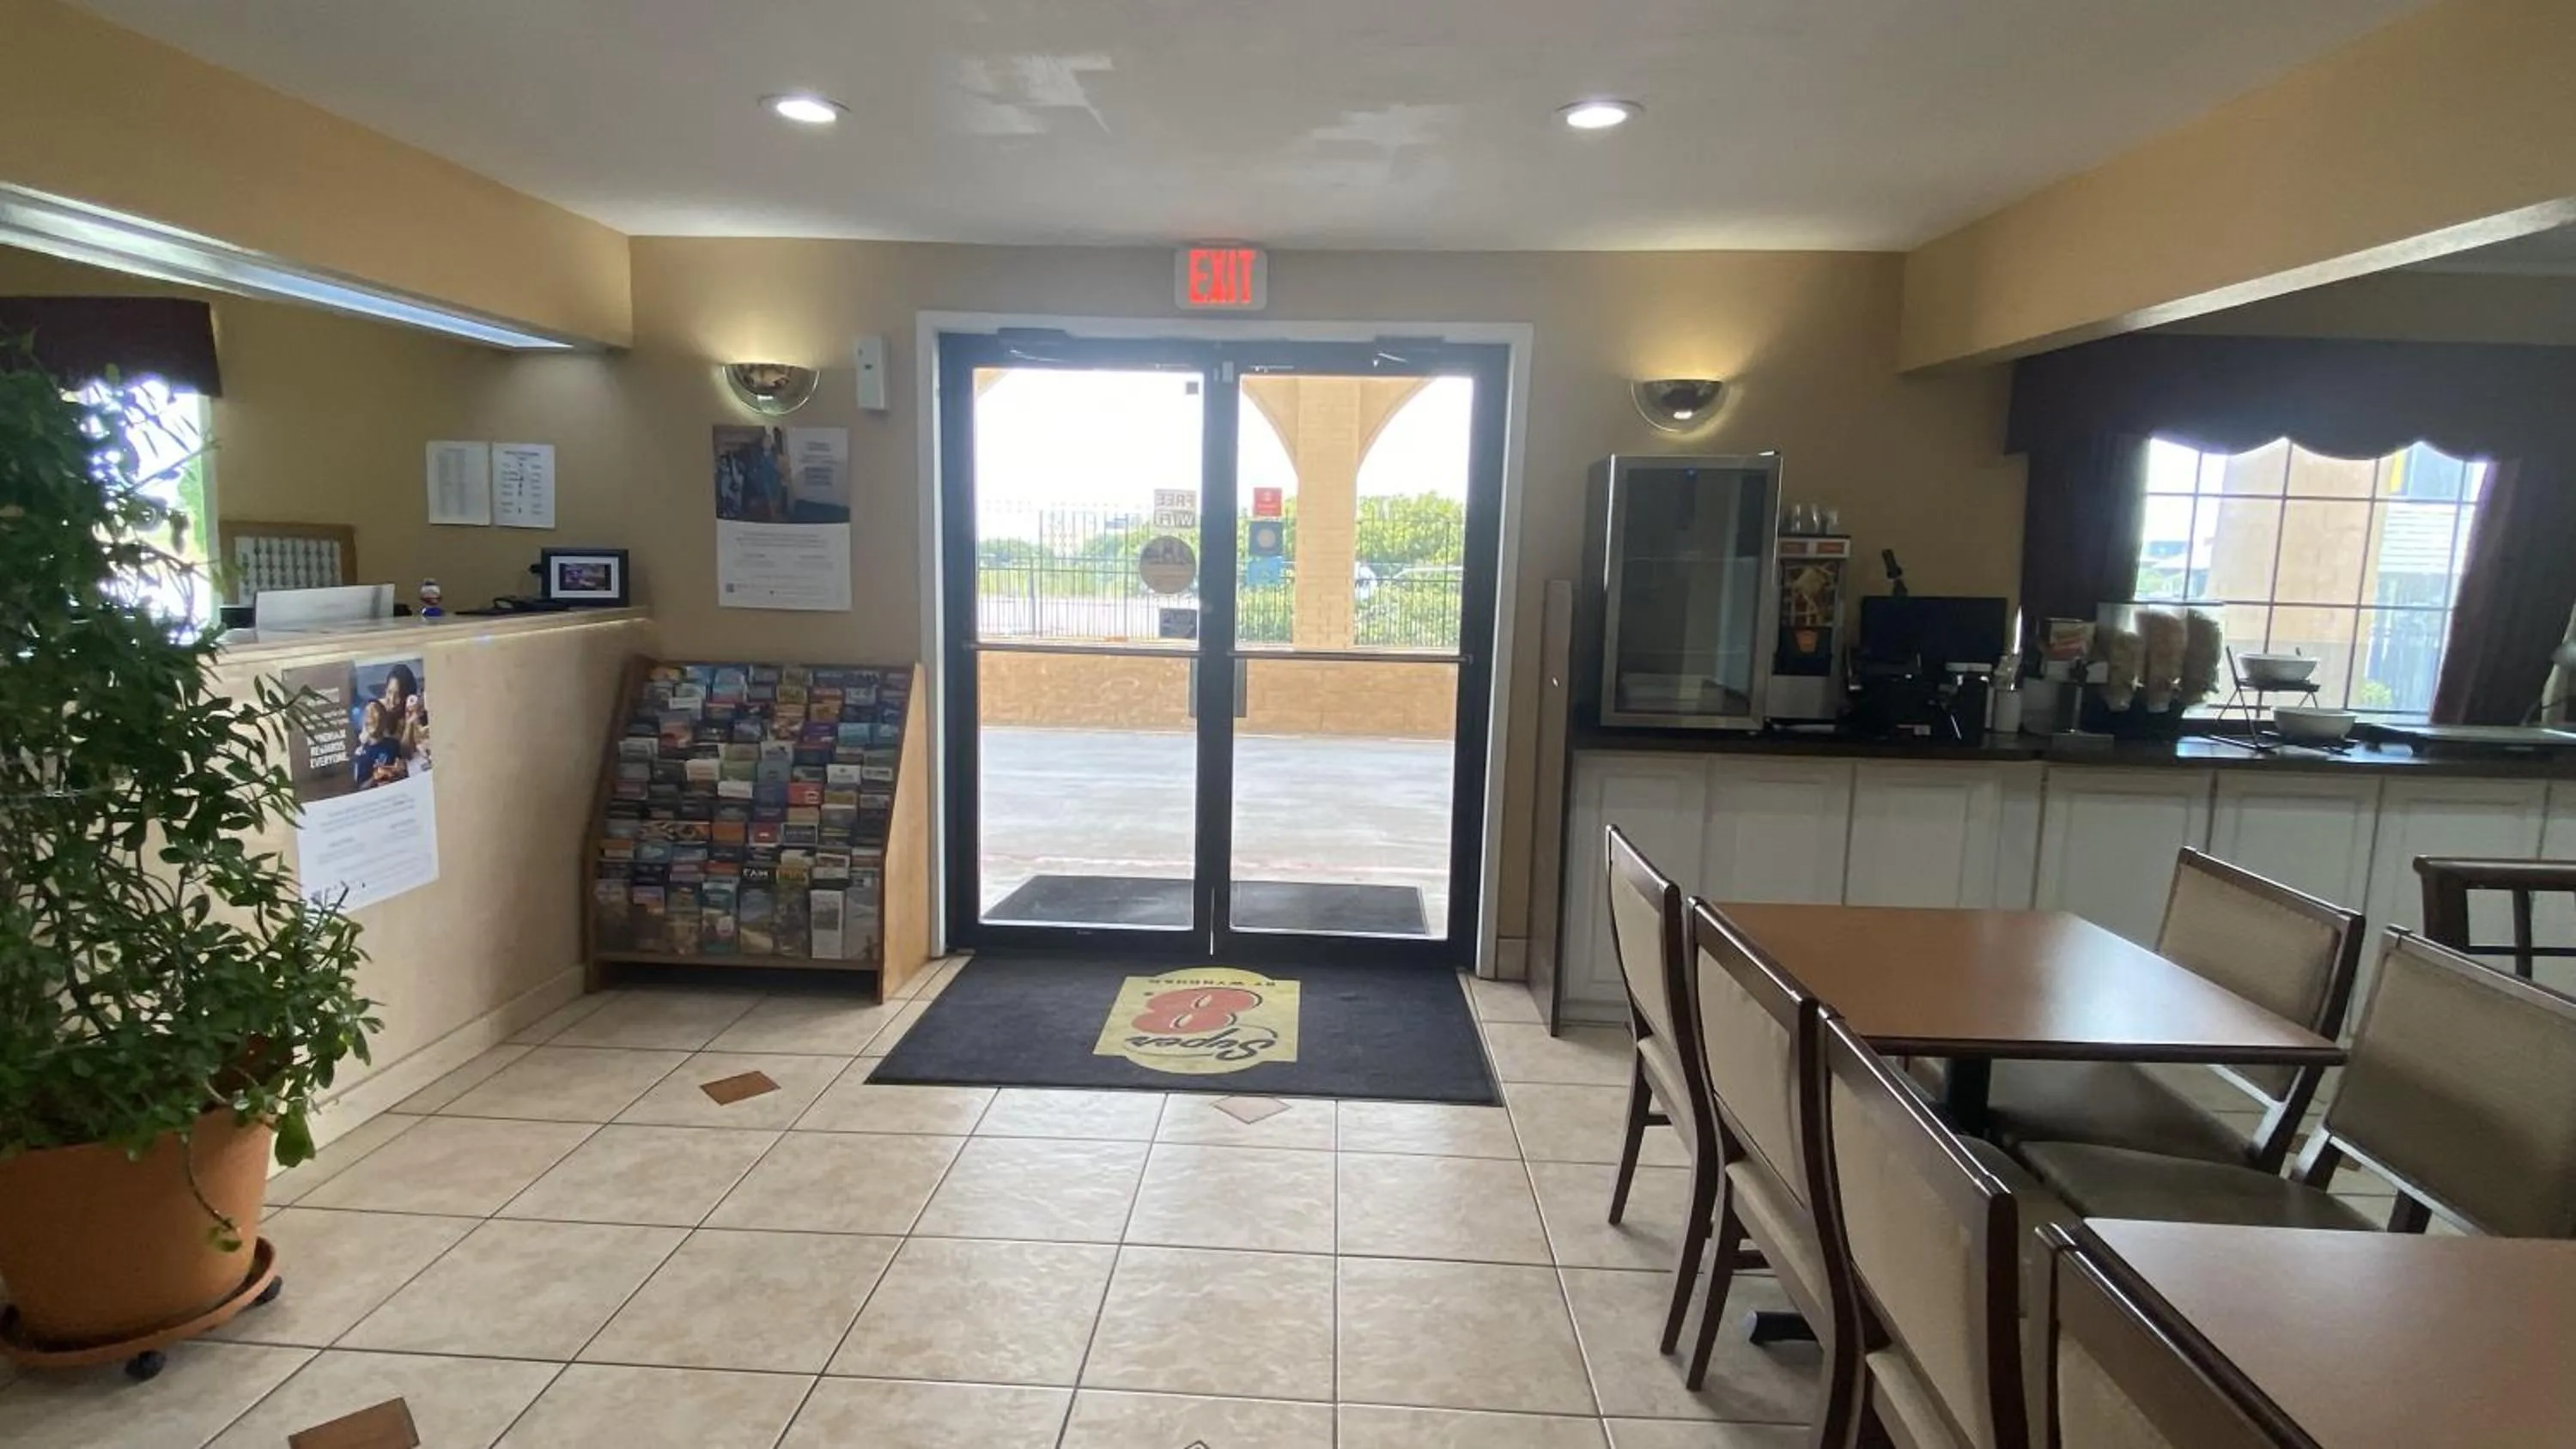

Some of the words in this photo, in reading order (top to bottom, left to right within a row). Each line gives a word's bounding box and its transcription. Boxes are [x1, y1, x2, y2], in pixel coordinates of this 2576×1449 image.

[1189, 248, 1256, 304] EXIT
[1148, 979, 1244, 987] WYNDHAM
[1131, 987, 1264, 1035] 8
[1125, 1028, 1277, 1061] Super
